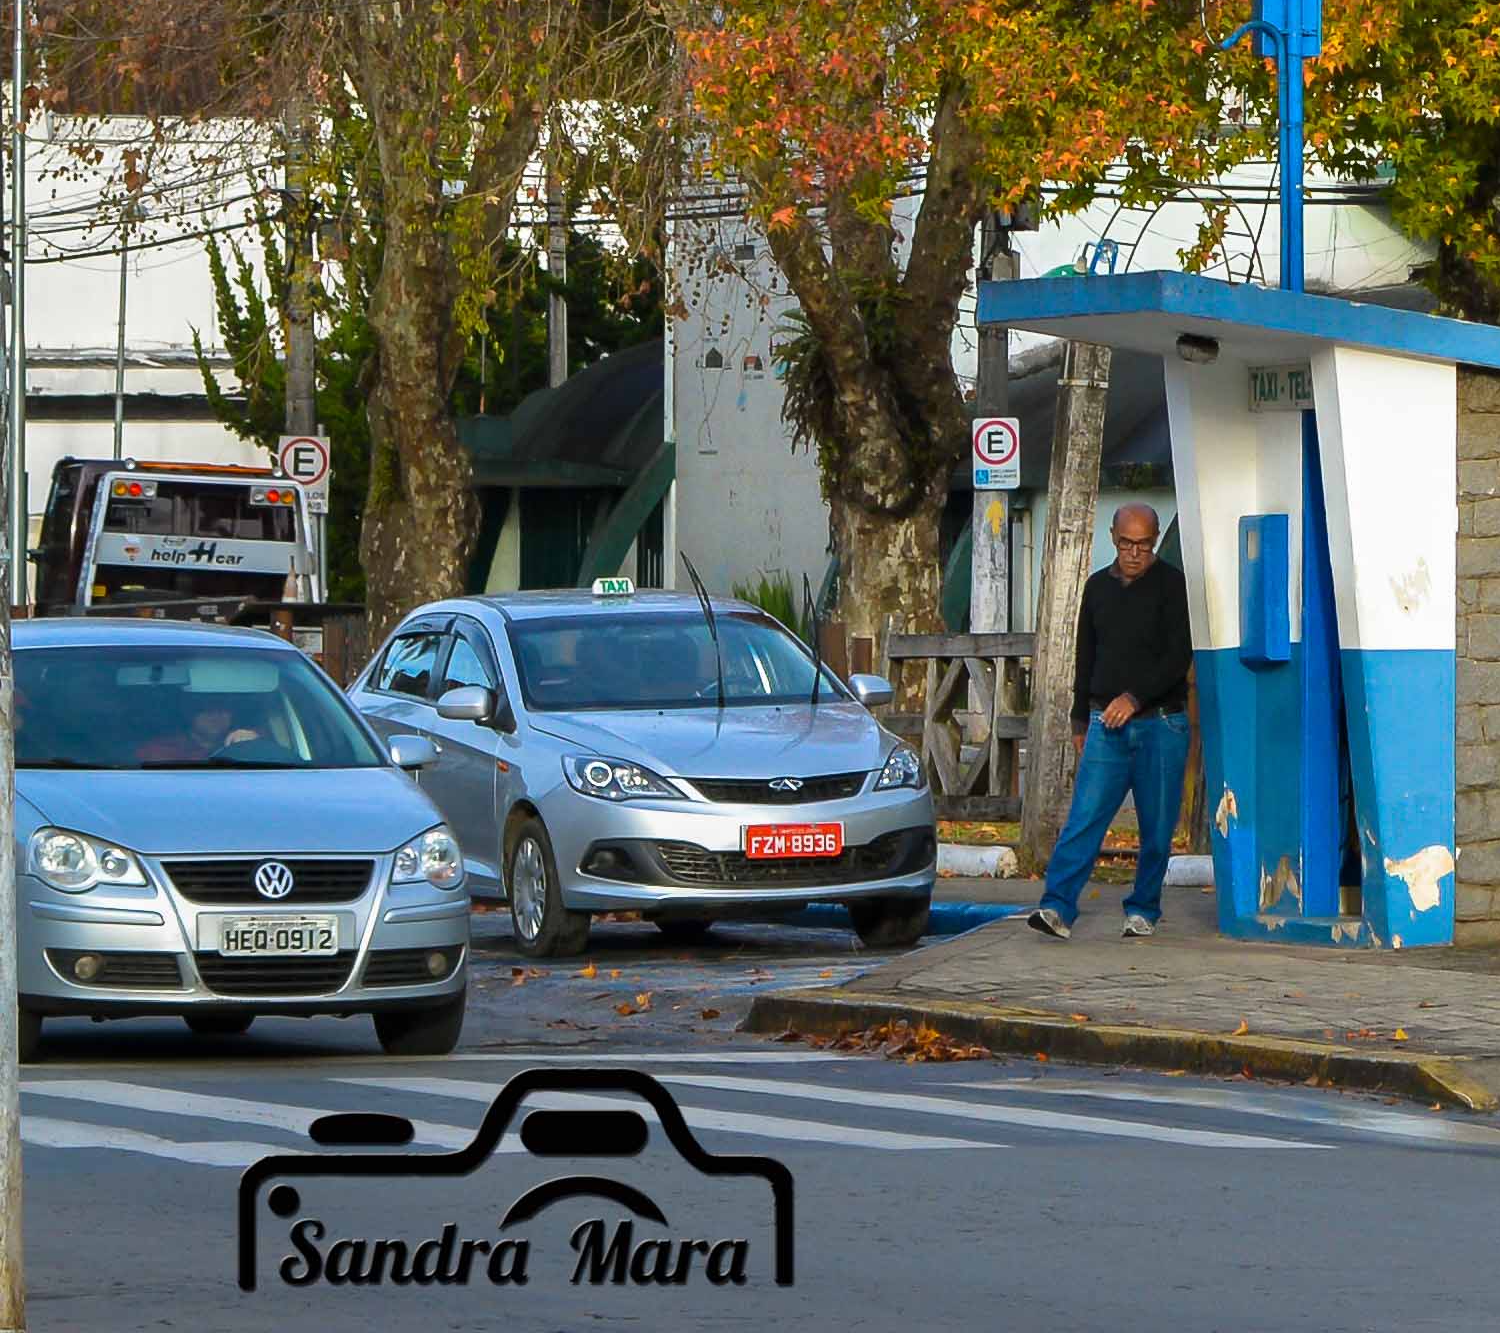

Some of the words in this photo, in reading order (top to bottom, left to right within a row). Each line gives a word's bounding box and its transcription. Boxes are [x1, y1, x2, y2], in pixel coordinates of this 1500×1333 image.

[1250, 372, 1279, 401] TAXI
[987, 431, 1005, 454] E
[293, 447, 316, 476] E
[599, 579, 629, 593] TAXI
[751, 834, 836, 854] FZM-8936
[225, 929, 333, 950] HEQ-0912
